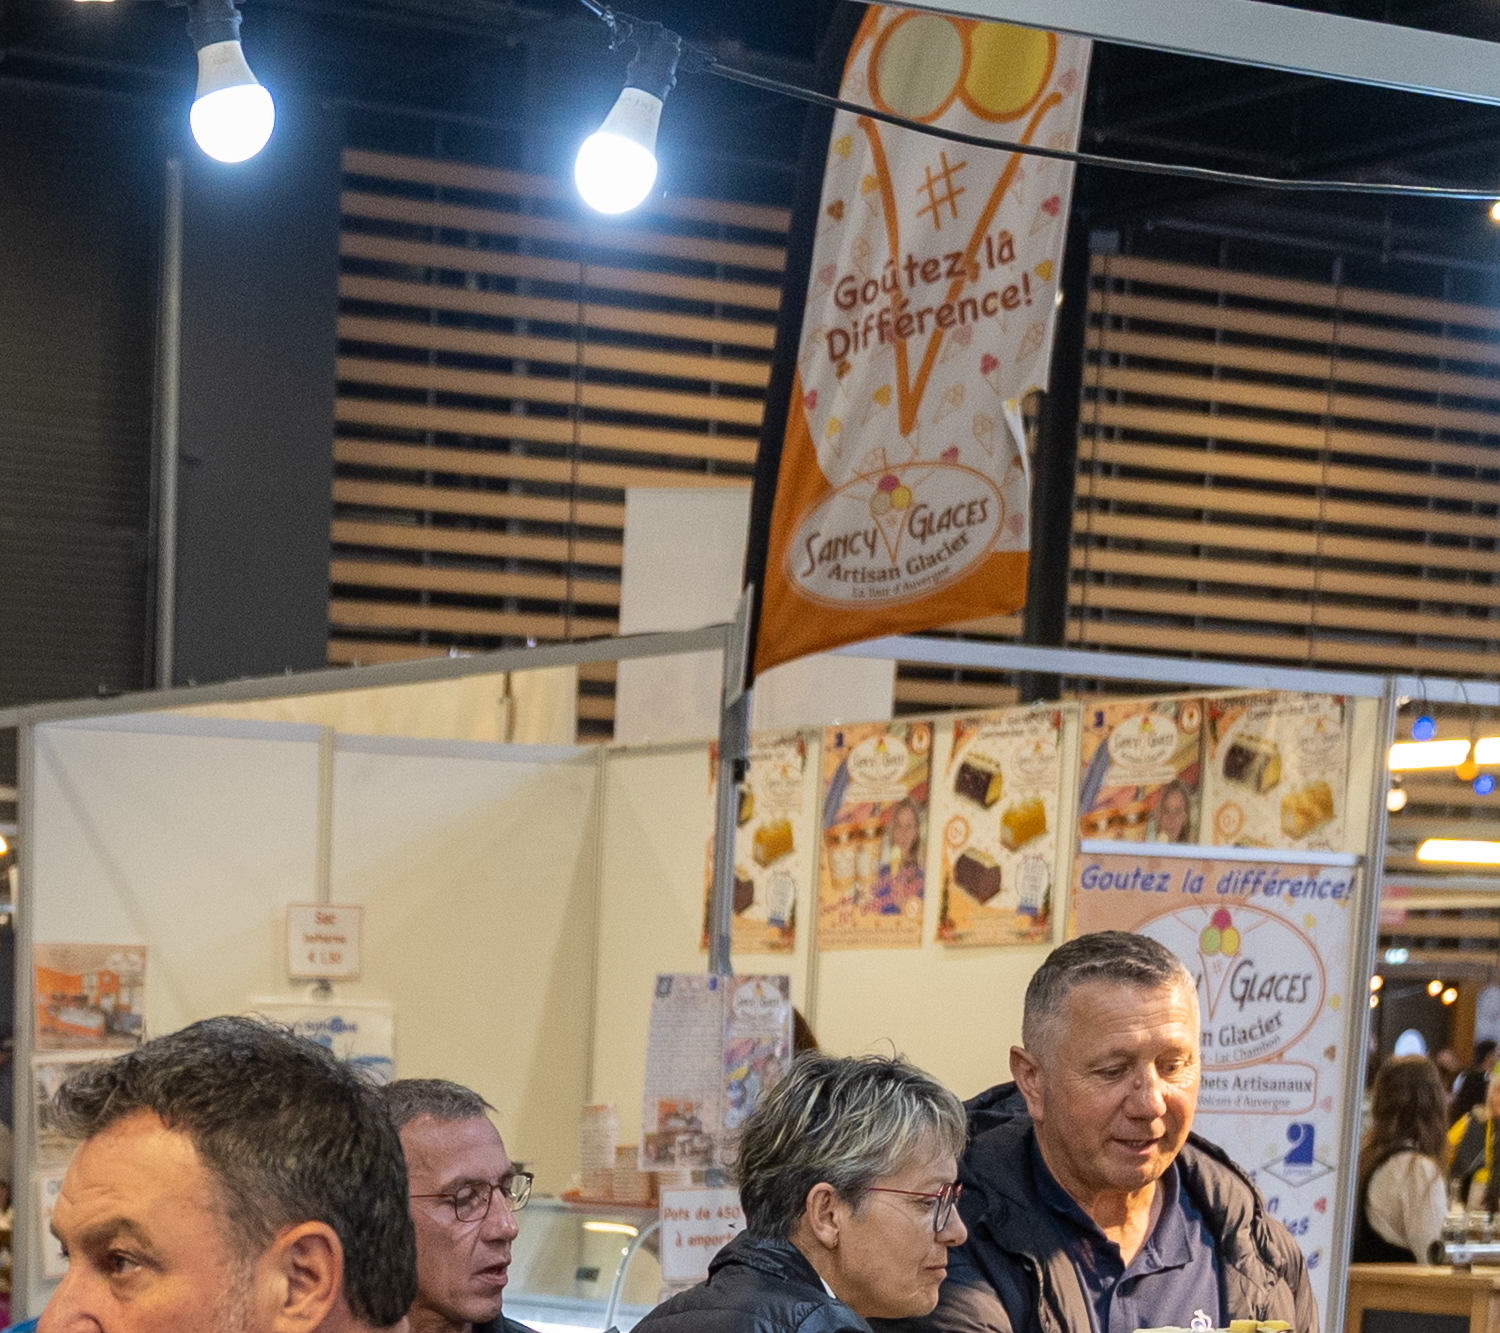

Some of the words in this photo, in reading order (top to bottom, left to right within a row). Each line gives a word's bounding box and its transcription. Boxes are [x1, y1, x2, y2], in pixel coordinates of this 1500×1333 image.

[986, 236, 1016, 269] la
[826, 271, 1033, 362] Différence!
[828, 563, 900, 584] Artisan
[905, 531, 970, 576] Glacier
[1080, 865, 1172, 894] Goutez
[1182, 868, 1206, 894] la
[1219, 1010, 1284, 1048] Glacier
[1200, 1074, 1229, 1092] bets
[1231, 1074, 1313, 1093] Artisanaux
[687, 1234, 734, 1250] emport
